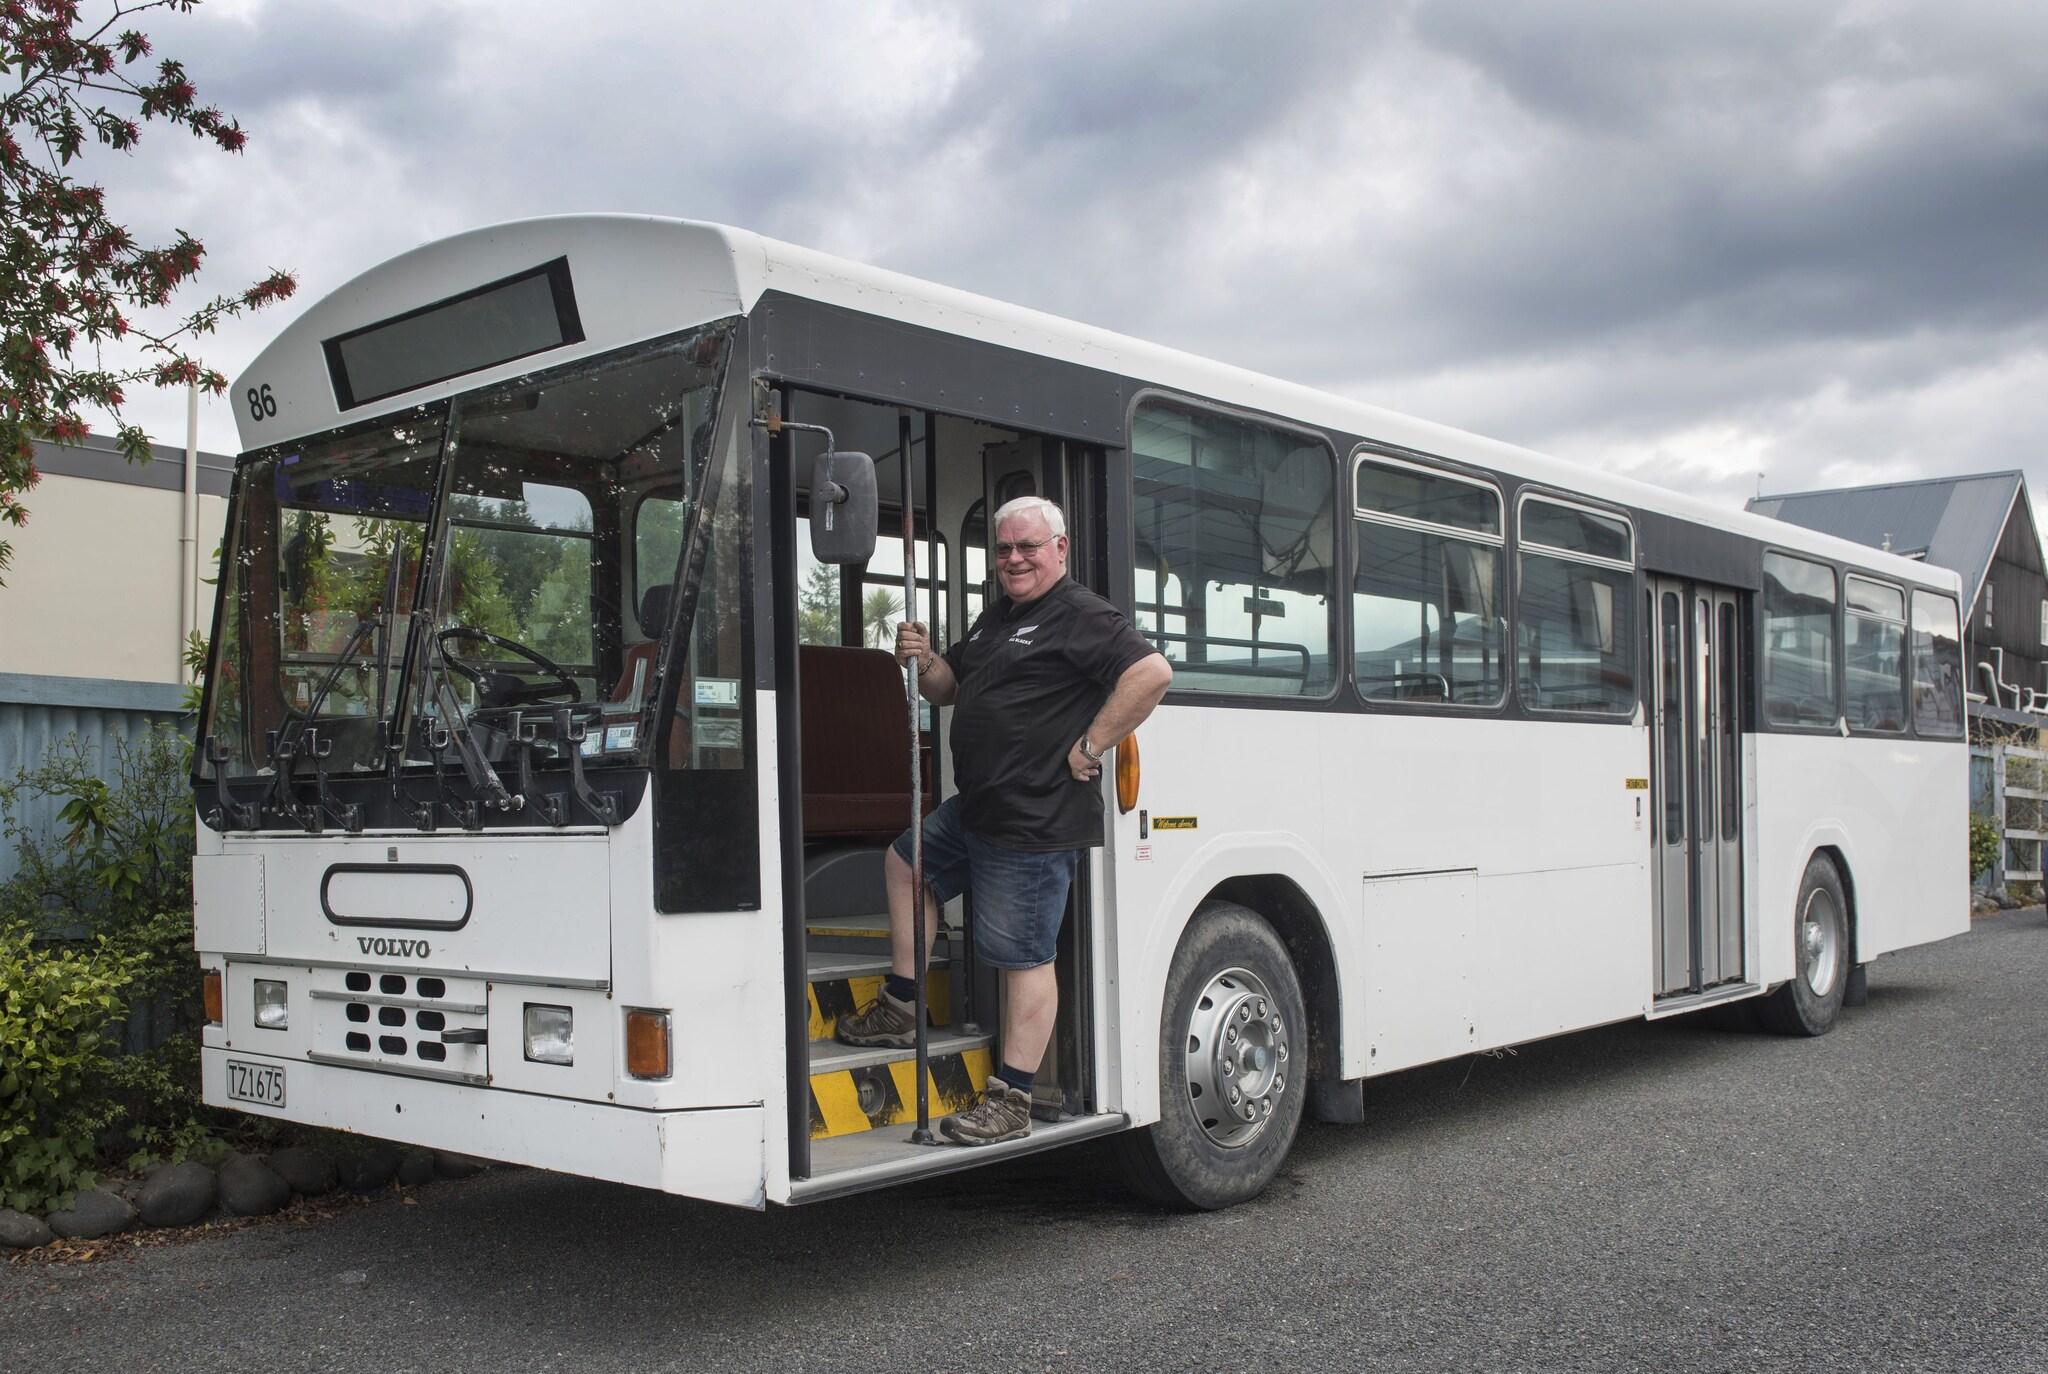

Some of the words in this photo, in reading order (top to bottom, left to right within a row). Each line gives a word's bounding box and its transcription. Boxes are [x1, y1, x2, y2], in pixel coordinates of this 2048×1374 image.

[247, 383, 277, 422] 86
[356, 936, 430, 959] VOLVO
[228, 1064, 283, 1102] TZ1675
